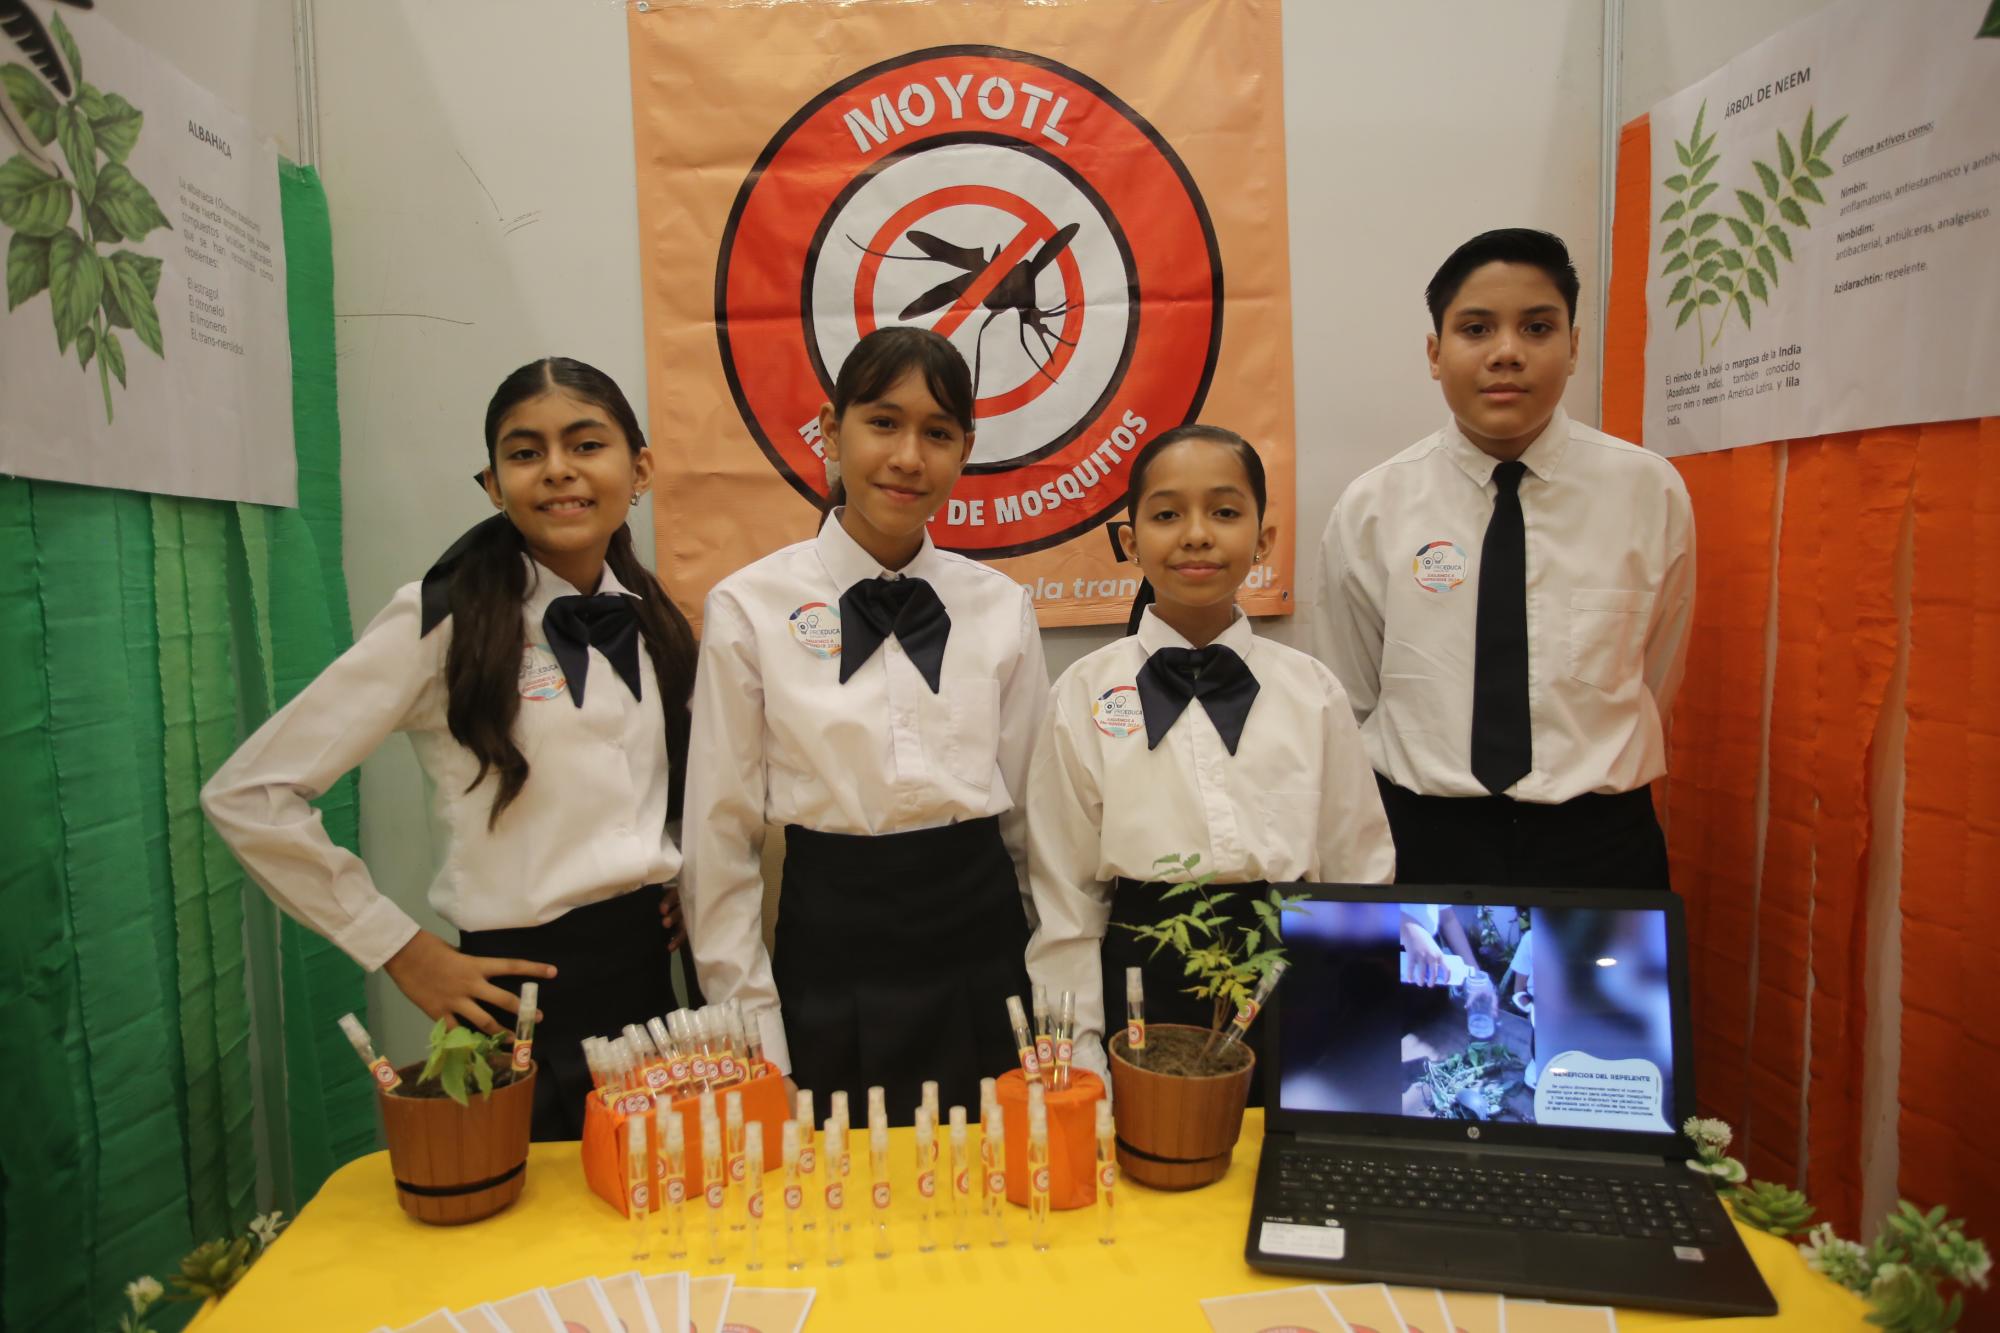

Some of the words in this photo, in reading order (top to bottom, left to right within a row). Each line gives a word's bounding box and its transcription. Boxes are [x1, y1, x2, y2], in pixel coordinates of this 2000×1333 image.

[1724, 93, 1754, 120] ÁRBOL
[1757, 84, 1772, 103] DE
[1775, 66, 1811, 95] NEEM
[843, 74, 1069, 154] MOYOTL
[188, 120, 232, 159] ALBAHACA
[1842, 143, 1875, 166] Contiene
[1876, 131, 1906, 152] activos
[1907, 120, 1935, 140] como:
[1962, 162, 1970, 175] y
[1665, 375, 1672, 386] El
[1673, 371, 1692, 383] nimbo
[1693, 369, 1701, 380] de
[1732, 355, 1760, 369] margosa
[1761, 352, 1769, 362] de
[1779, 344, 1802, 357] India
[1765, 360, 1801, 377] conocido
[1683, 398, 1695, 410] nim
[1702, 395, 1718, 407] neem
[1727, 385, 1754, 401] América
[1786, 376, 1800, 388] lila
[946, 499, 985, 527] DE
[994, 408, 1148, 525] MOSQUITOS
[1020, 576, 1064, 600] ola
